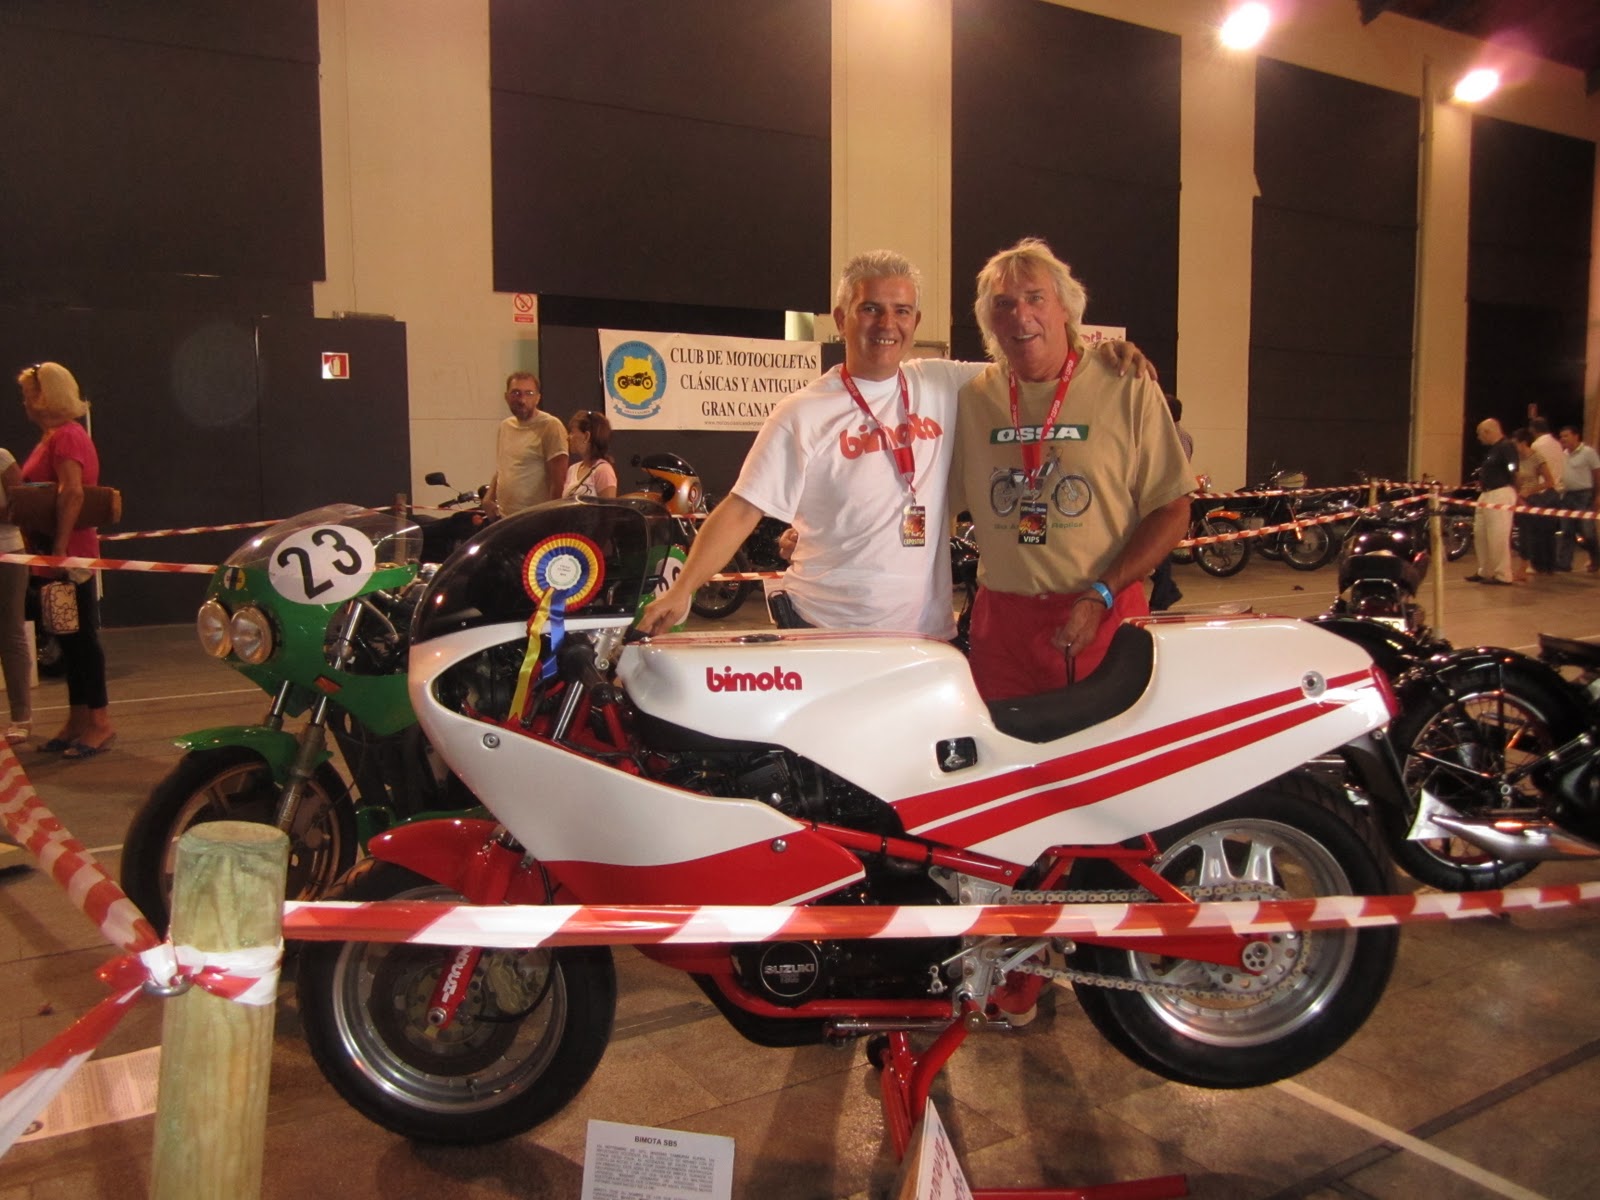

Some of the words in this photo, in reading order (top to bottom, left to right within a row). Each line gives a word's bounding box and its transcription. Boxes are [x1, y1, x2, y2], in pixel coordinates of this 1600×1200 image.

[670, 347, 704, 364] CLUB
[707, 349, 723, 365] DE
[726, 350, 817, 370] MOTOCICLETAS
[680, 370, 739, 392] CLÁSICAS
[741, 377, 749, 392] Y
[701, 401, 735, 417] GRAN
[839, 412, 943, 460] bimota
[996, 427, 1081, 441] OSSA
[1023, 535, 1040, 544] VIPS
[277, 528, 362, 599] 23
[706, 665, 803, 692] bimota
[764, 963, 815, 974] SUZUKI
[635, 1136, 662, 1145] BIMOTA
[664, 1139, 678, 1147] SB5
